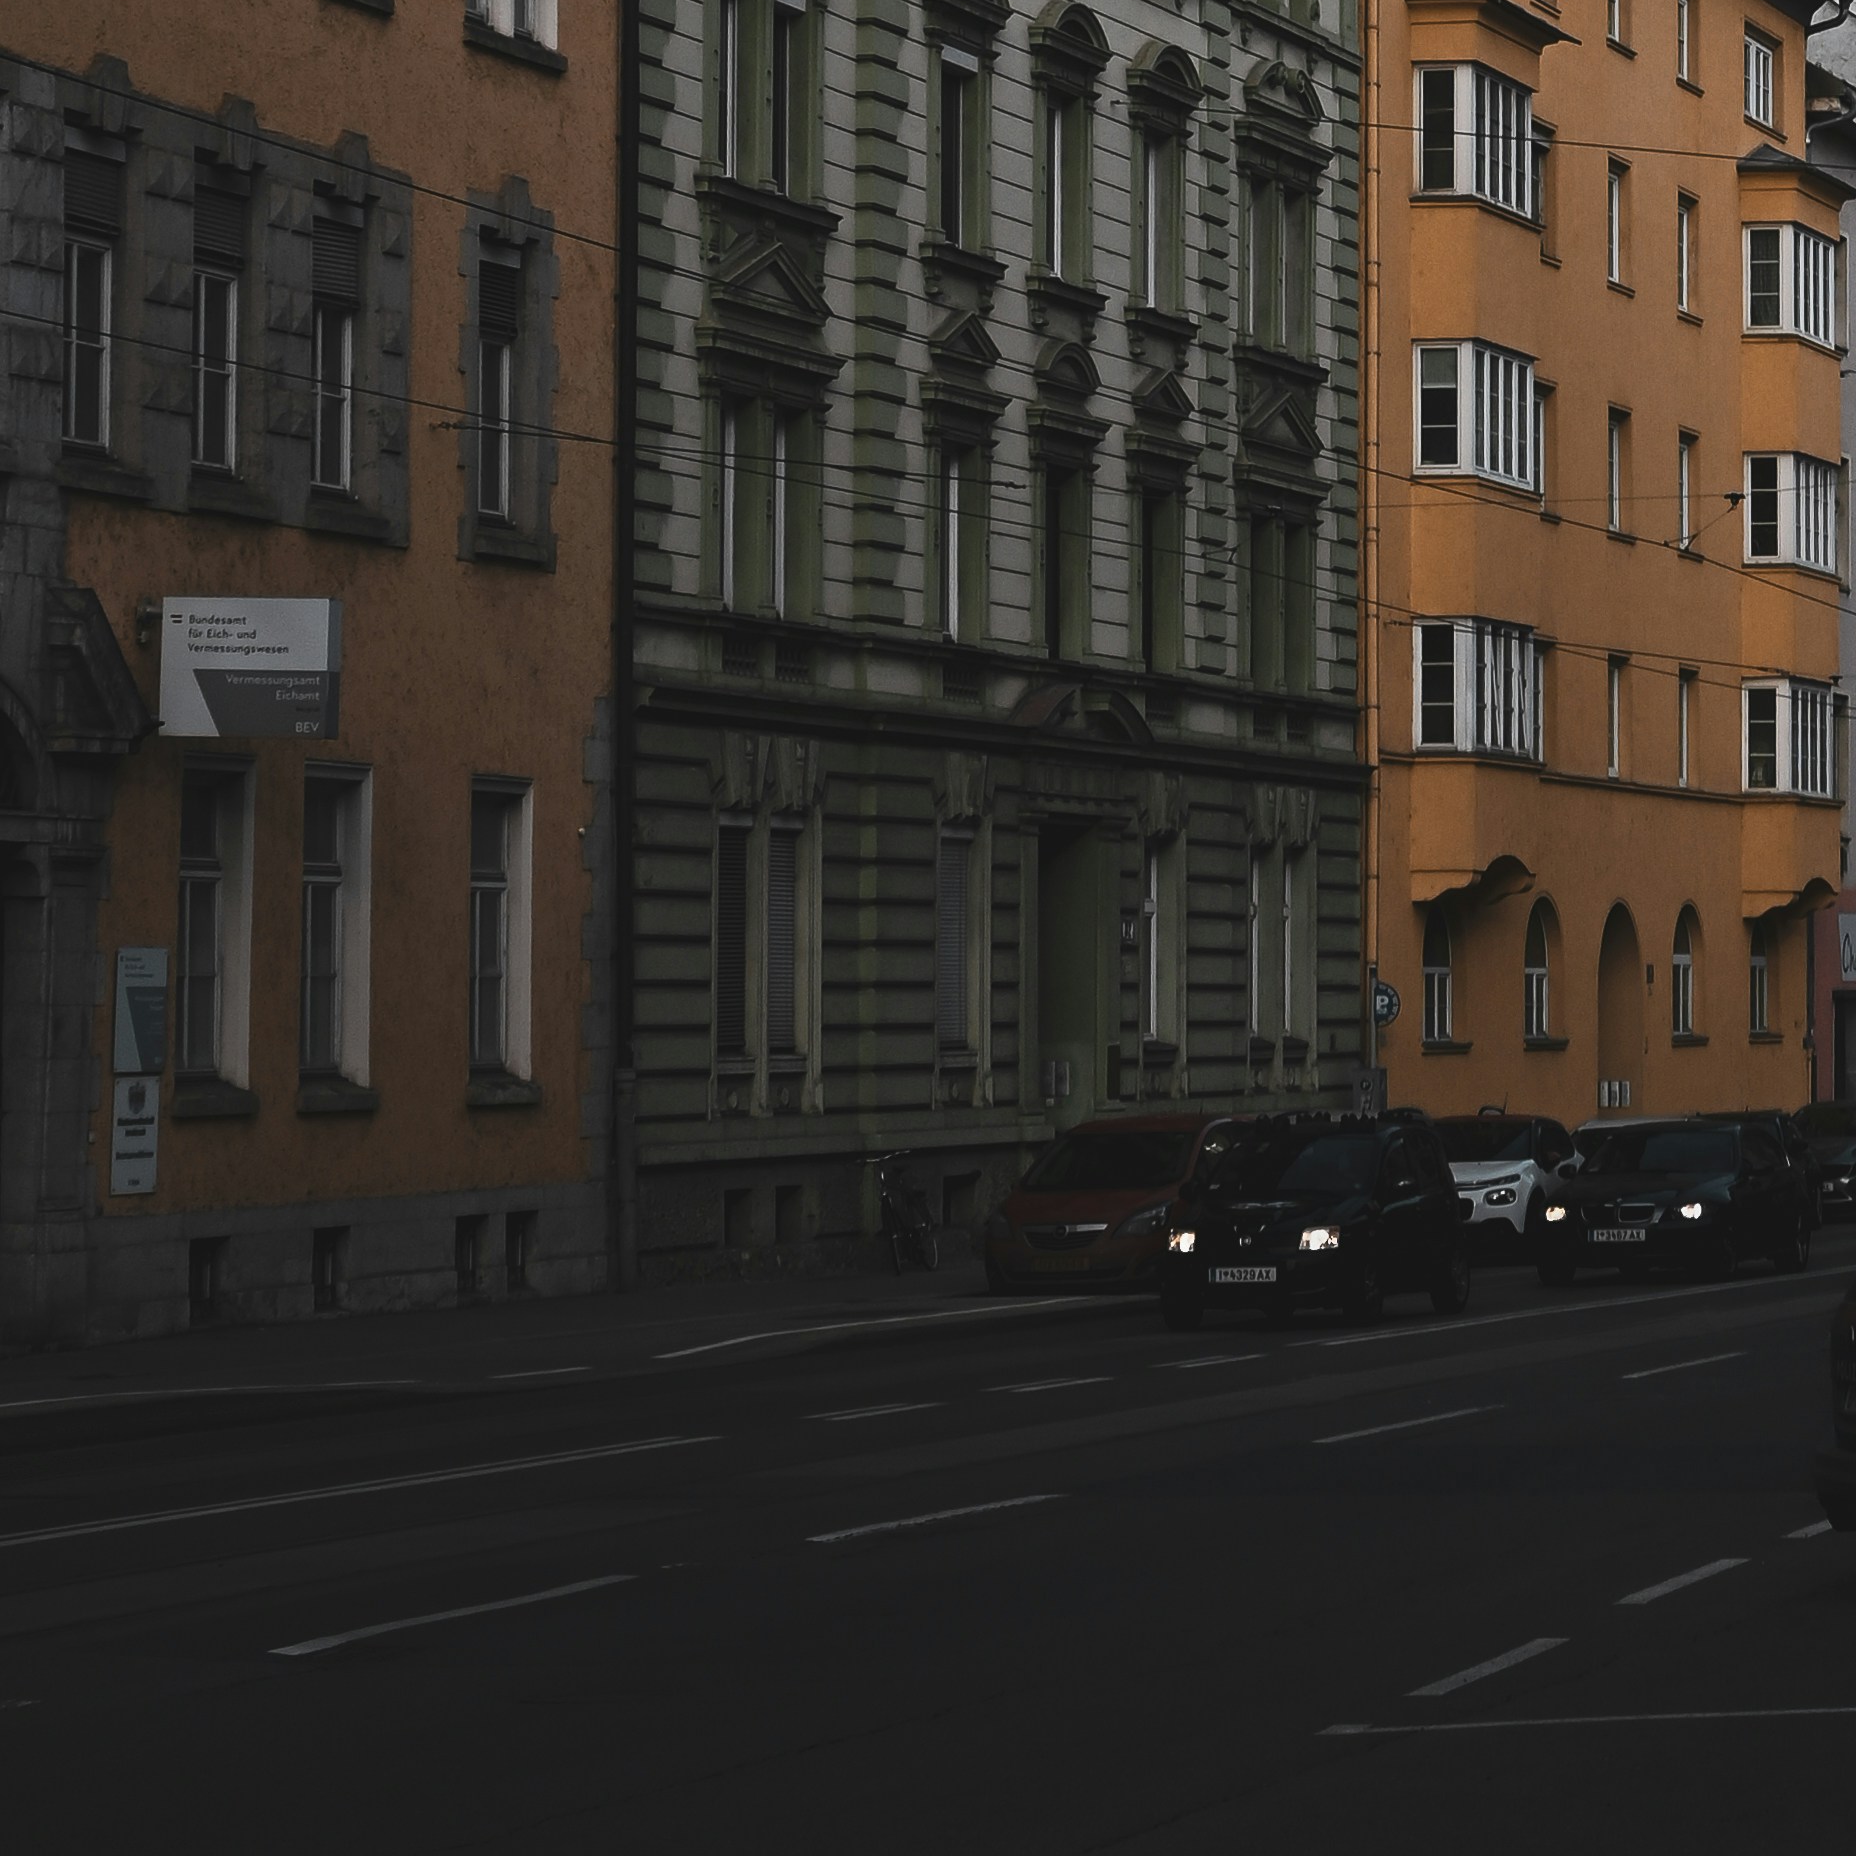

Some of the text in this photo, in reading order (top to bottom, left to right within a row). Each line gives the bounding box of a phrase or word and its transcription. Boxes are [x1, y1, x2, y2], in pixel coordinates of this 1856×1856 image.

[189, 614, 247, 625] Bundesamt
[188, 628, 257, 639] für Eich- und
[187, 643, 289, 656] Vermessungswesen
[225, 674, 321, 688] Vermessungsamt
[275, 690, 320, 701] Eichamt
[295, 722, 320, 734] BEV
[1376, 995, 1389, 1011] P
